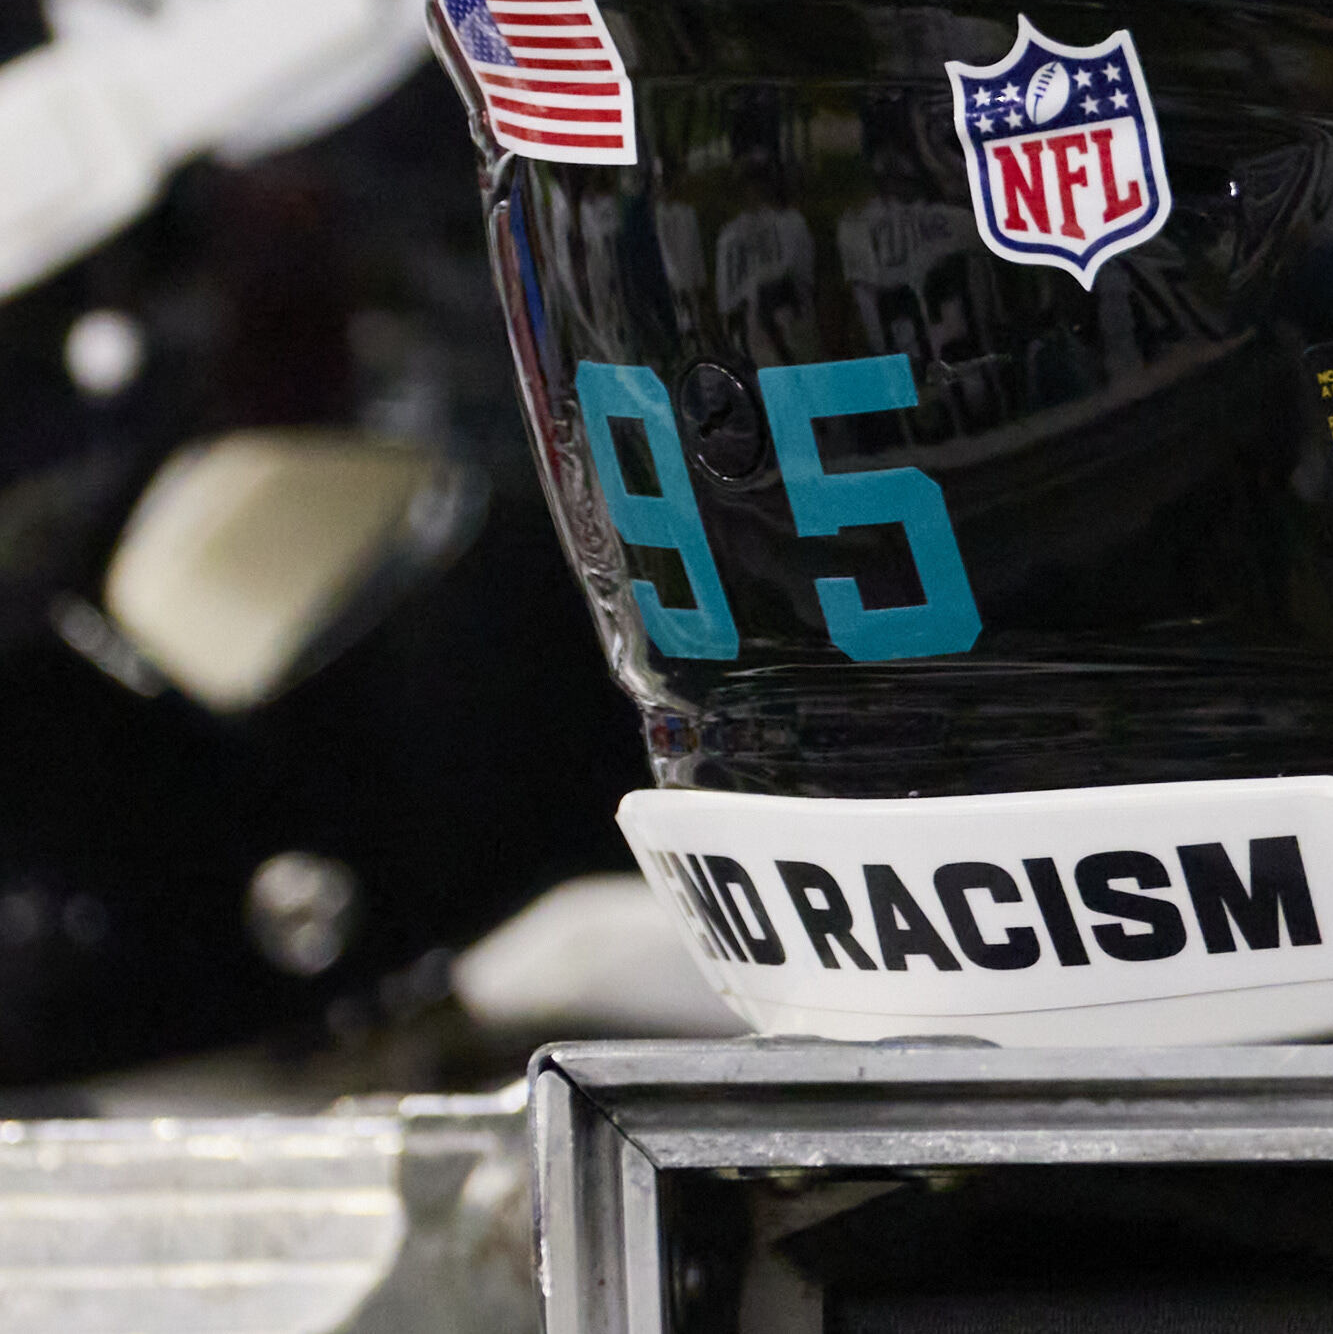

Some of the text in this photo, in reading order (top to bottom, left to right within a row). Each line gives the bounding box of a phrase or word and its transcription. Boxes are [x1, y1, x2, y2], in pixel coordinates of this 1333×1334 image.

[992, 126, 1143, 241] NFL
[575, 353, 983, 662] 95
[773, 834, 1323, 972] RACISM
